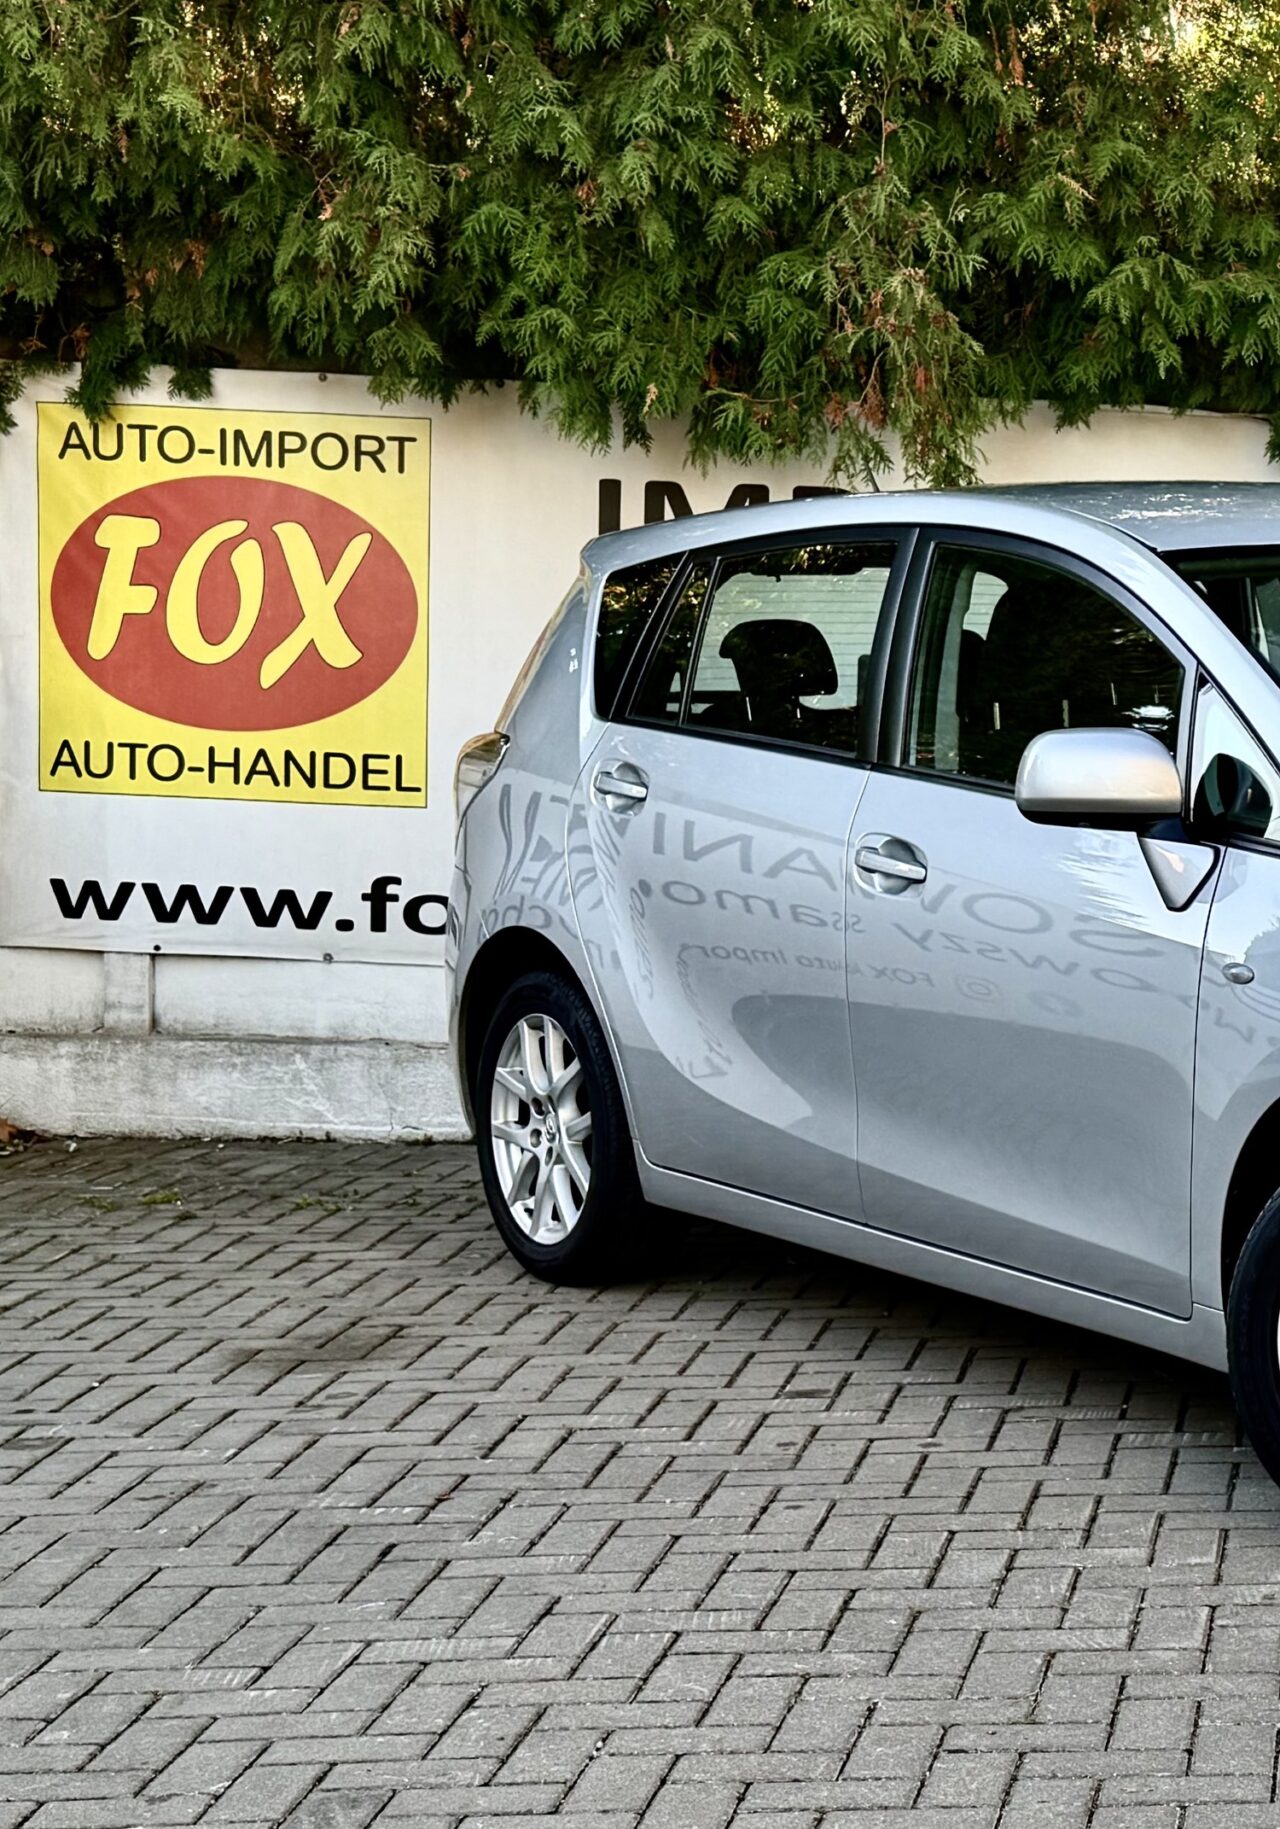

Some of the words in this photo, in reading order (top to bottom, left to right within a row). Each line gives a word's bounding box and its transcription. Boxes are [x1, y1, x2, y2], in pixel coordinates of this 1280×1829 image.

[58, 421, 417, 474] AUTO-IMPORT
[87, 514, 373, 690] FOX
[50, 739, 422, 793] AUTO-HANDEL
